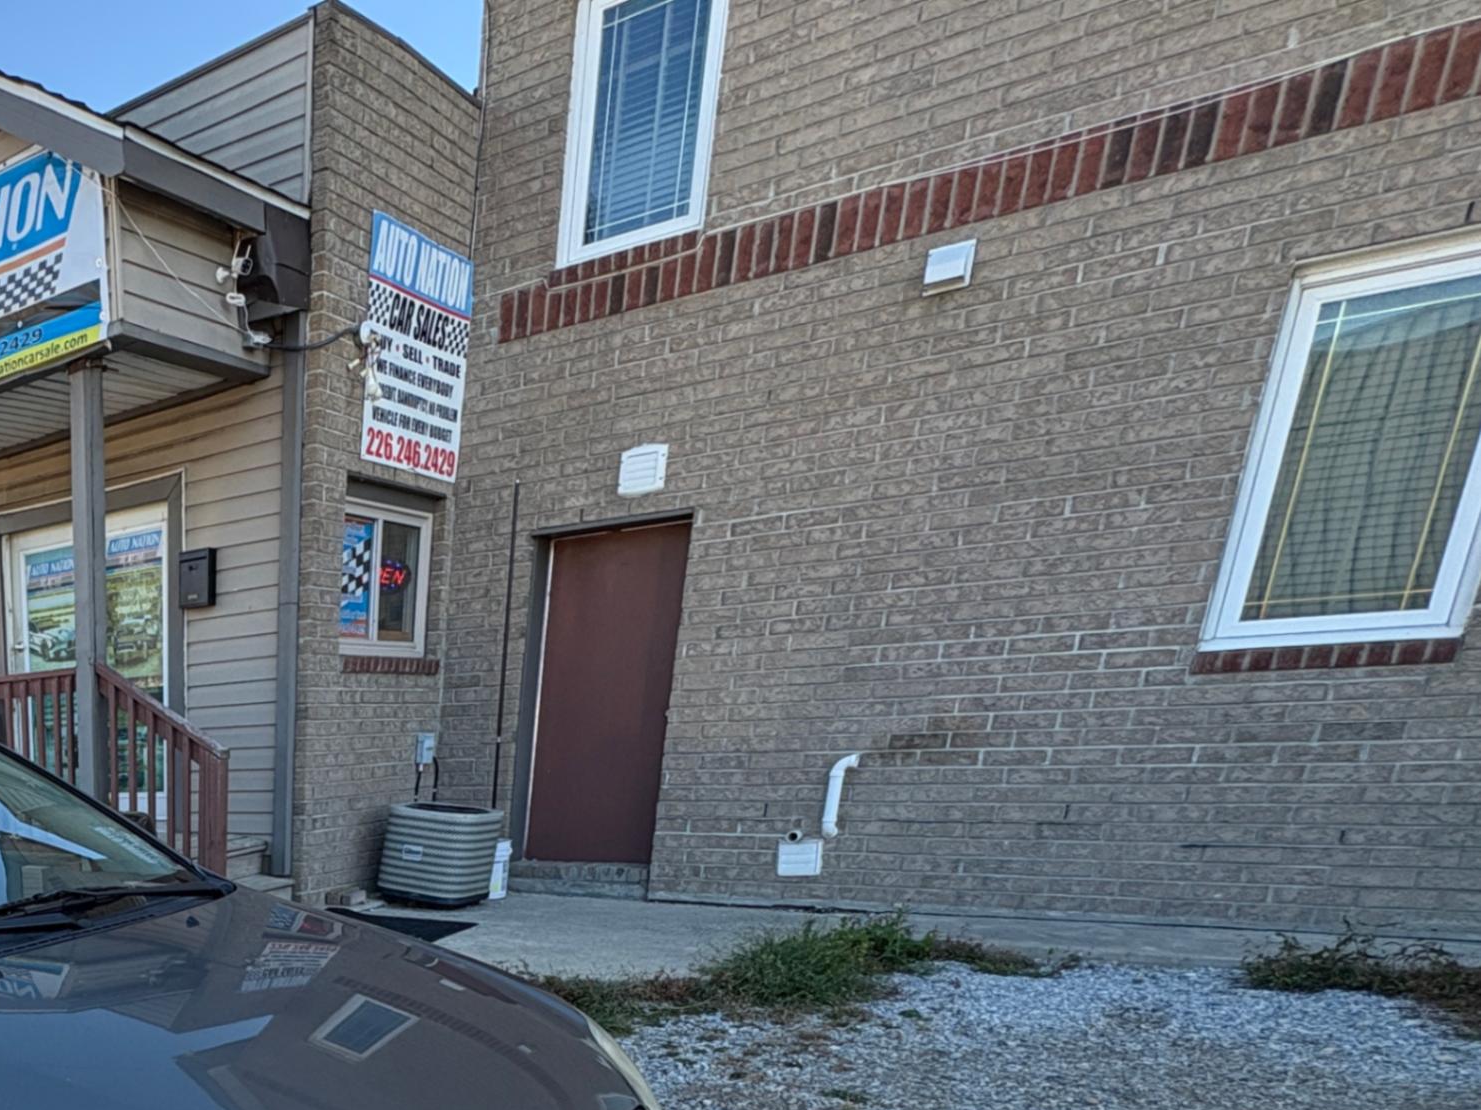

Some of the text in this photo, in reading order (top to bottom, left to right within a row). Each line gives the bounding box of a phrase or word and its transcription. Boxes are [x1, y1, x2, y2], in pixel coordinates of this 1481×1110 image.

[373, 220, 470, 311] AUTO NATION
[389, 291, 450, 351] CAR SALES
[389, 362, 416, 385] FINANCE
[417, 372, 454, 399] EVERYBODY
[402, 343, 423, 365] SELL
[432, 355, 461, 379] TRADE
[372, 405, 398, 428] VEHICLE
[365, 426, 455, 477] 226.246.2429
